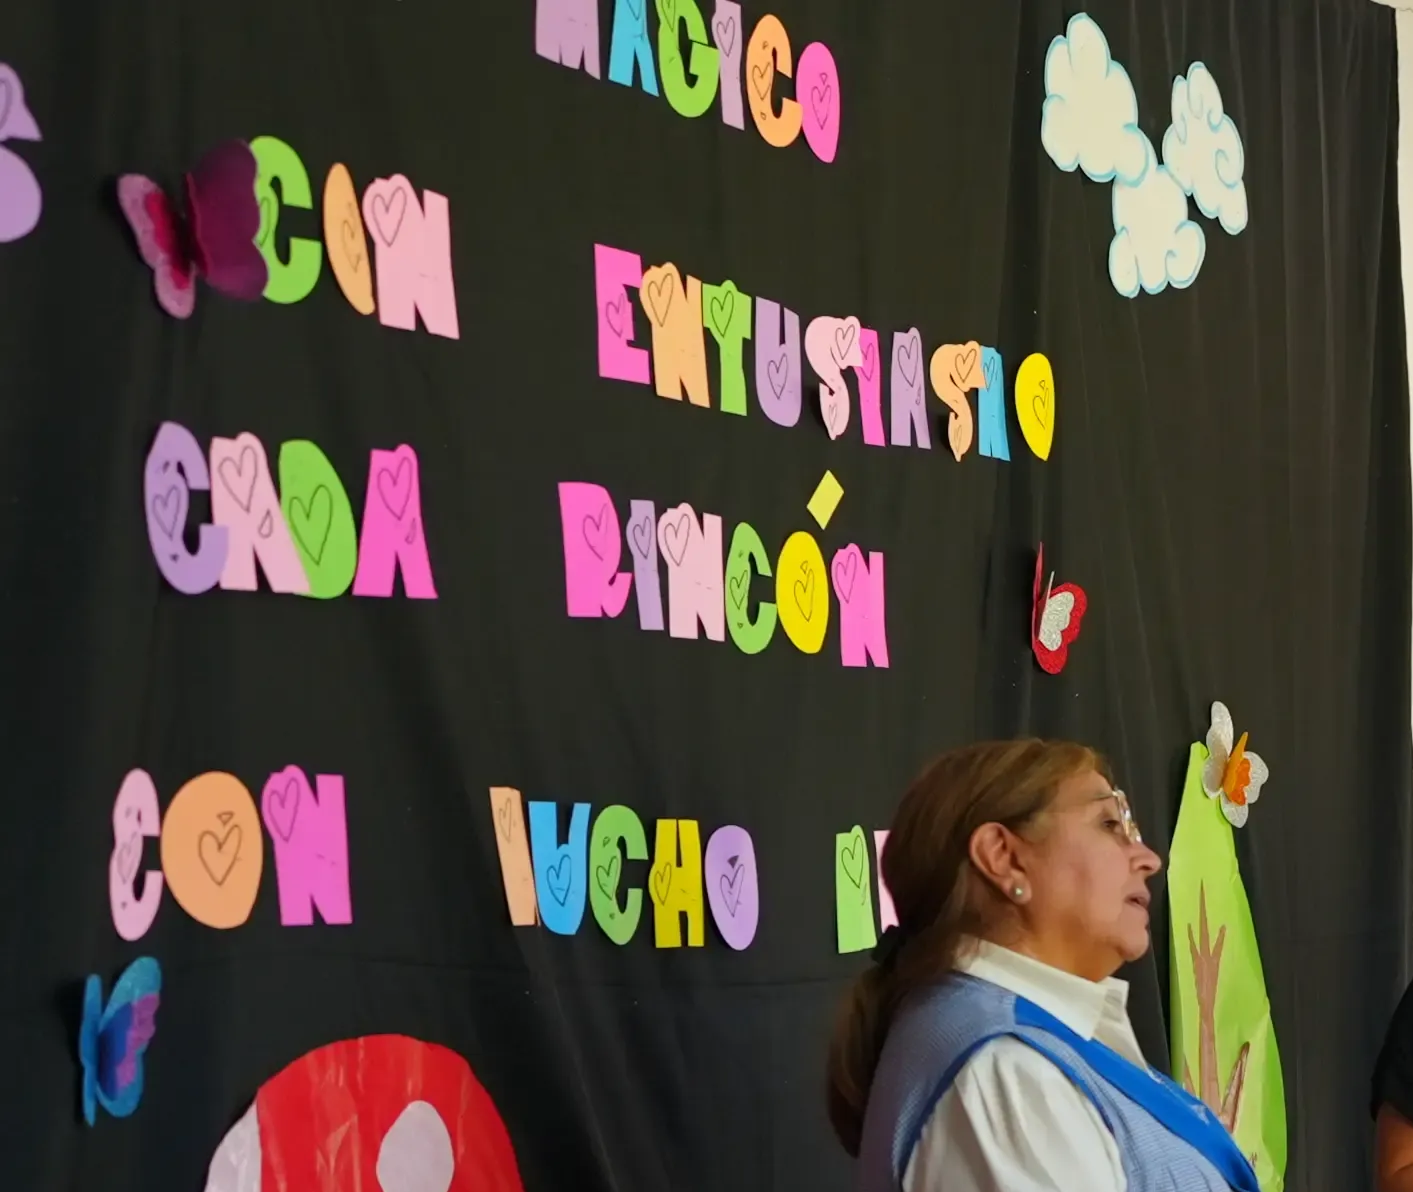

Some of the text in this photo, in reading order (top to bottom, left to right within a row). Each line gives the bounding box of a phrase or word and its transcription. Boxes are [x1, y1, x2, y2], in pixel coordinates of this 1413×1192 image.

[248, 135, 461, 340] CON
[593, 243, 1056, 463] ENTUSIASMO
[143, 420, 890, 668] CADA RINCÓN
[108, 764, 354, 942] CON
